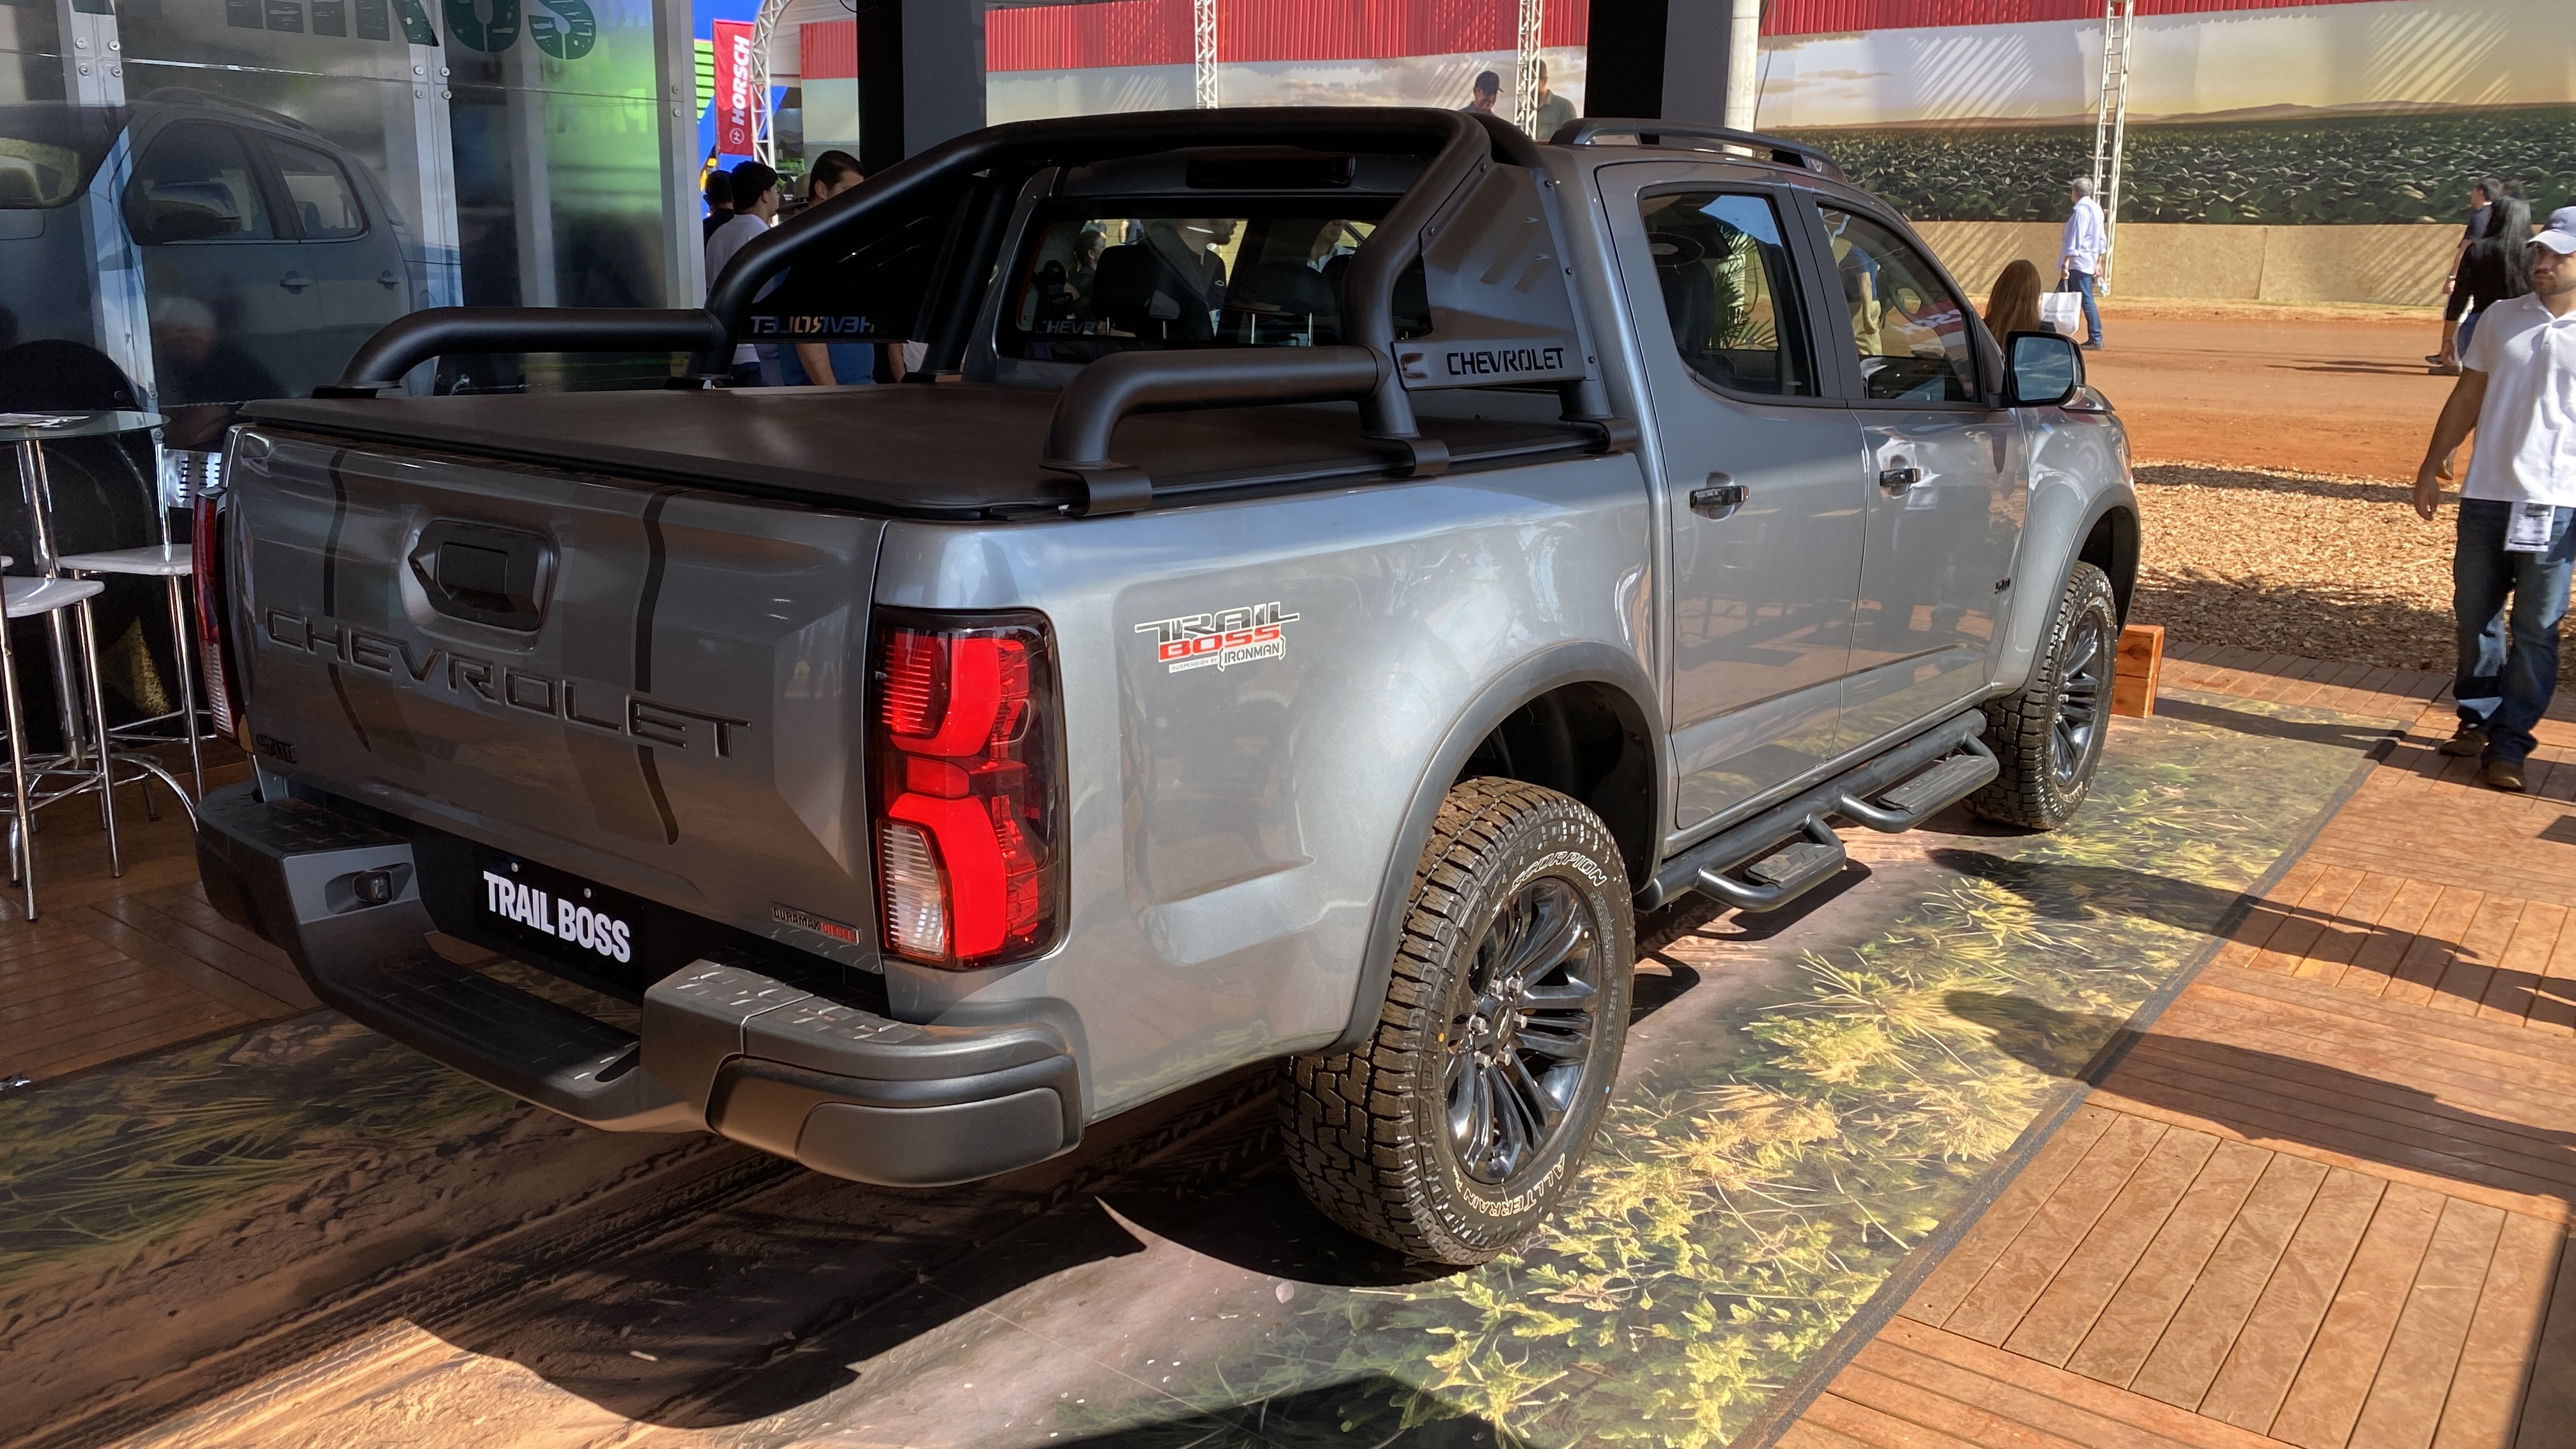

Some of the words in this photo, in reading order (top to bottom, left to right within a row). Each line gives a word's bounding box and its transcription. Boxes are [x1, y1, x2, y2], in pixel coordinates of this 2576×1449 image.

[732, 34, 751, 126] HORSCH
[1446, 347, 1564, 376] CHEVROLET
[1135, 601, 1300, 643] TRAIL
[1159, 624, 1280, 661] BOSS
[1171, 660, 1209, 671] SUSPENSION
[1225, 642, 1280, 663] IRONMAN
[266, 608, 752, 760] CHEVROLET
[1508, 851, 1607, 896] SCORPION
[484, 871, 555, 935] TRAIL
[558, 898, 631, 963] BOSS
[772, 907, 820, 931] DURAMAX
